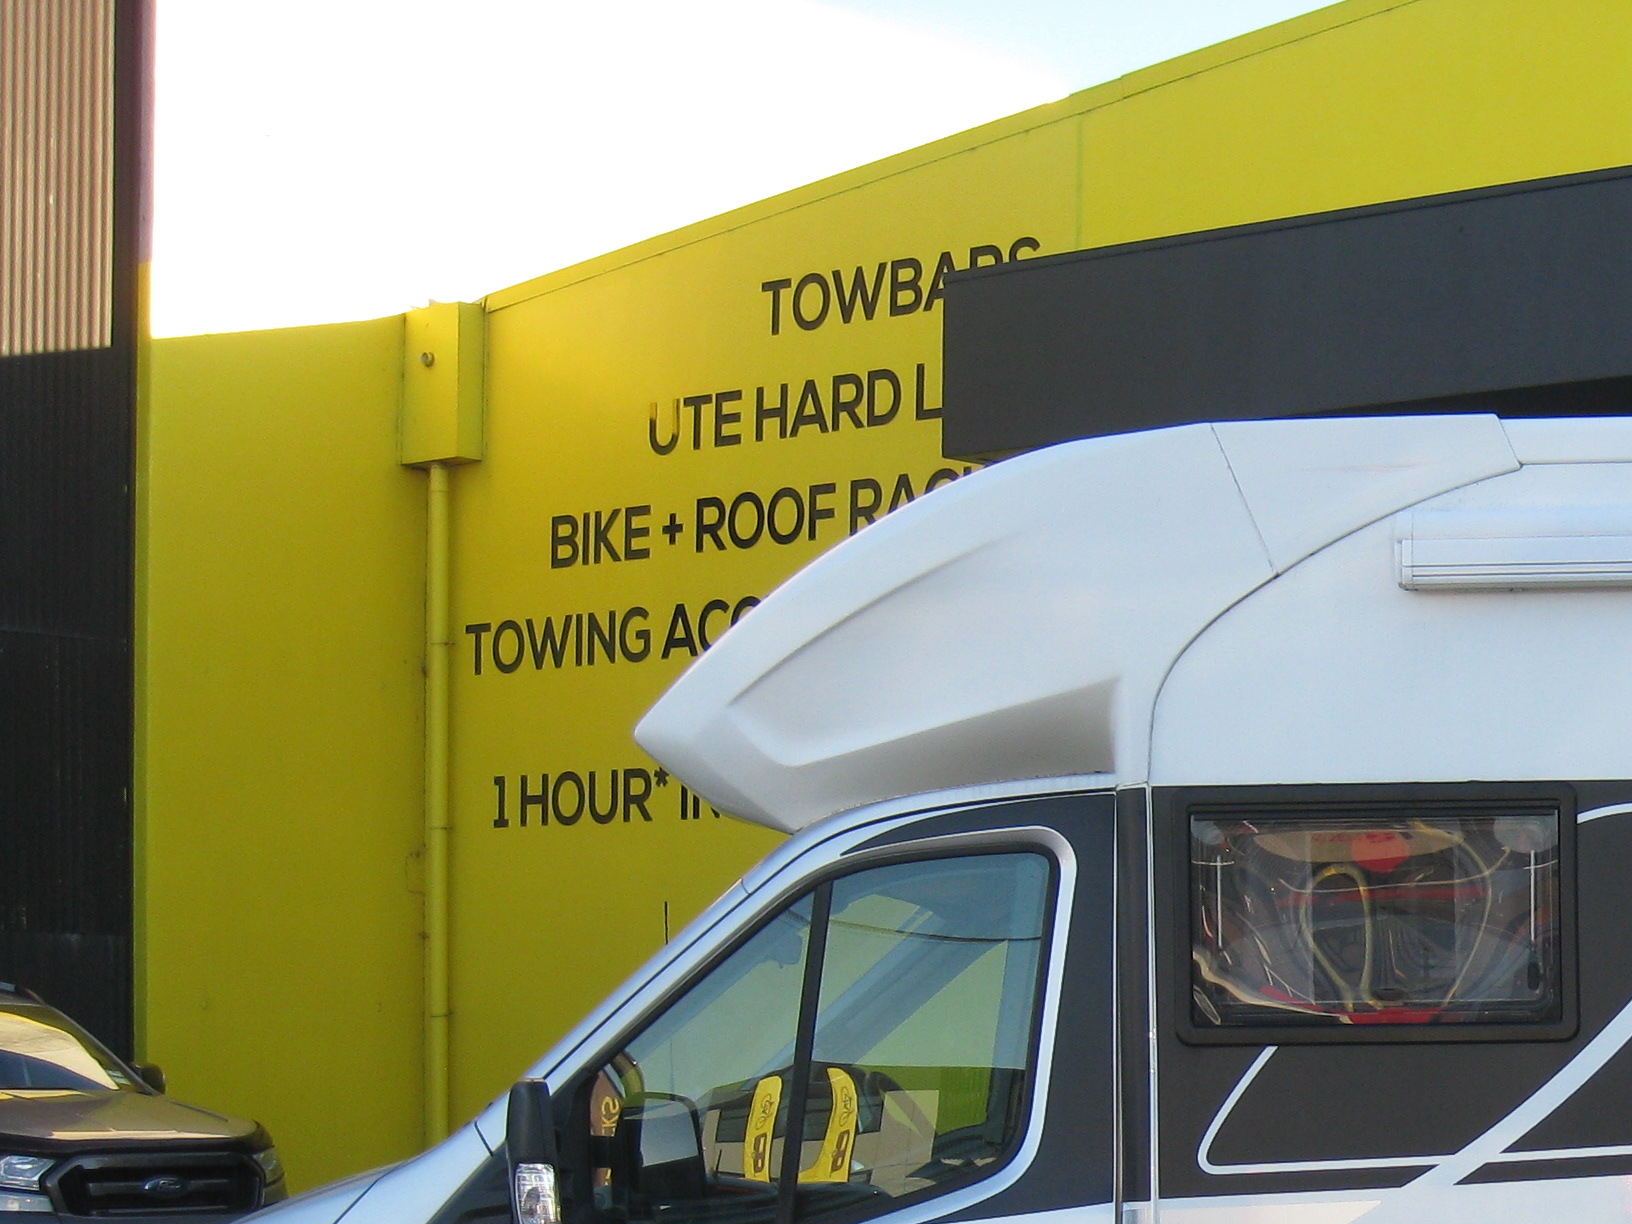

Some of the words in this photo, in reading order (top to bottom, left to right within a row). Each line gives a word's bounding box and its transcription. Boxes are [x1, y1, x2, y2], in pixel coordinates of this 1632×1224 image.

[648, 389, 743, 455] UTE
[755, 367, 902, 442] HARD
[550, 503, 651, 569] BIKE
[695, 482, 837, 554] ROOF
[465, 605, 652, 676] TOWING
[493, 775, 510, 829] 1
